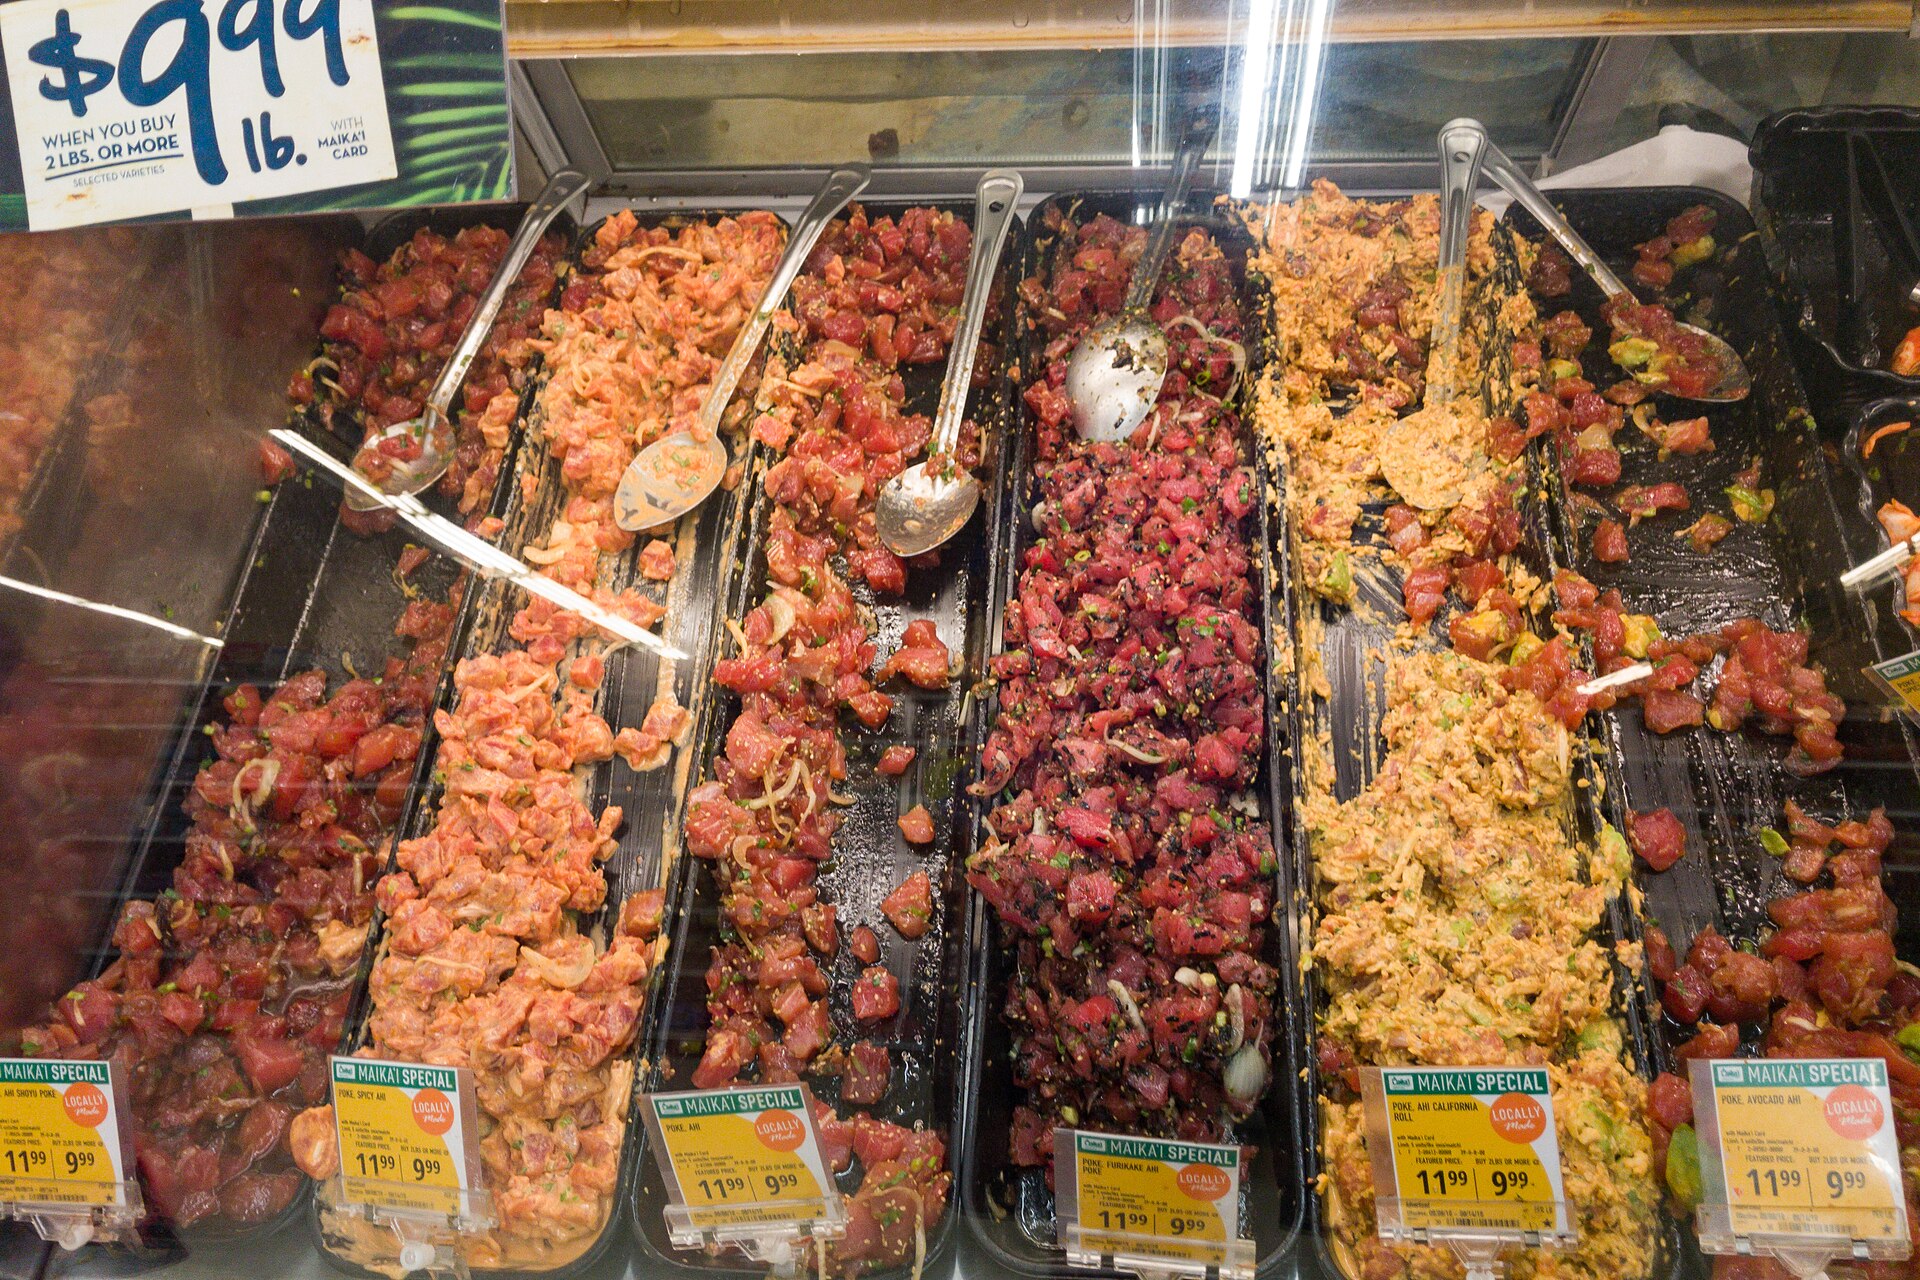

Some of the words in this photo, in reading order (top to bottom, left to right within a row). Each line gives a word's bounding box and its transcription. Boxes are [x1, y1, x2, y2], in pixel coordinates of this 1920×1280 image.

[42, 128, 95, 150] WHEN
[99, 120, 136, 140] YOU
[141, 113, 176, 133] BUY
[331, 116, 363, 131] WITH
[241, 111, 308, 173] lb.
[45, 156, 56, 170] 2
[59, 150, 94, 168] LBS.
[98, 143, 122, 160] OR
[127, 134, 179, 156] MORE
[333, 145, 368, 160] CARD
[73, 172, 118, 187] SELECTED
[120, 165, 165, 179] VARIETIES
[51, 1065, 105, 1081] SPECIAL
[402, 1070, 453, 1088] SPECIAL
[1809, 1064, 1881, 1083] SPECIAL
[1476, 1073, 1544, 1091] SPECIAL
[64, 1094, 104, 1108] LOCALLY
[357, 1090, 374, 1100] SPICY
[376, 1091, 386, 1101] AHI
[739, 1090, 799, 1110] SPECIAL
[1748, 1095, 1784, 1104] AVOCADO
[1788, 1095, 1801, 1104] AHI
[413, 1101, 450, 1114] LOCALLY
[1417, 1102, 1430, 1111] AHI
[1432, 1102, 1478, 1111] CALIFORNIA
[1491, 1106, 1541, 1122] LOCALLY
[1827, 1099, 1878, 1116] LOCALLY
[1394, 1112, 1413, 1122] ROLL
[688, 1122, 701, 1131] AHI
[756, 1119, 800, 1135] LOCALLY
[1168, 1146, 1233, 1165] SPECIAL
[1083, 1166, 1102, 1175] POKE
[1107, 1161, 1143, 1172] FURIKAKE
[1146, 1165, 1159, 1173] AHI
[1179, 1173, 1227, 1185] LOCALLY
